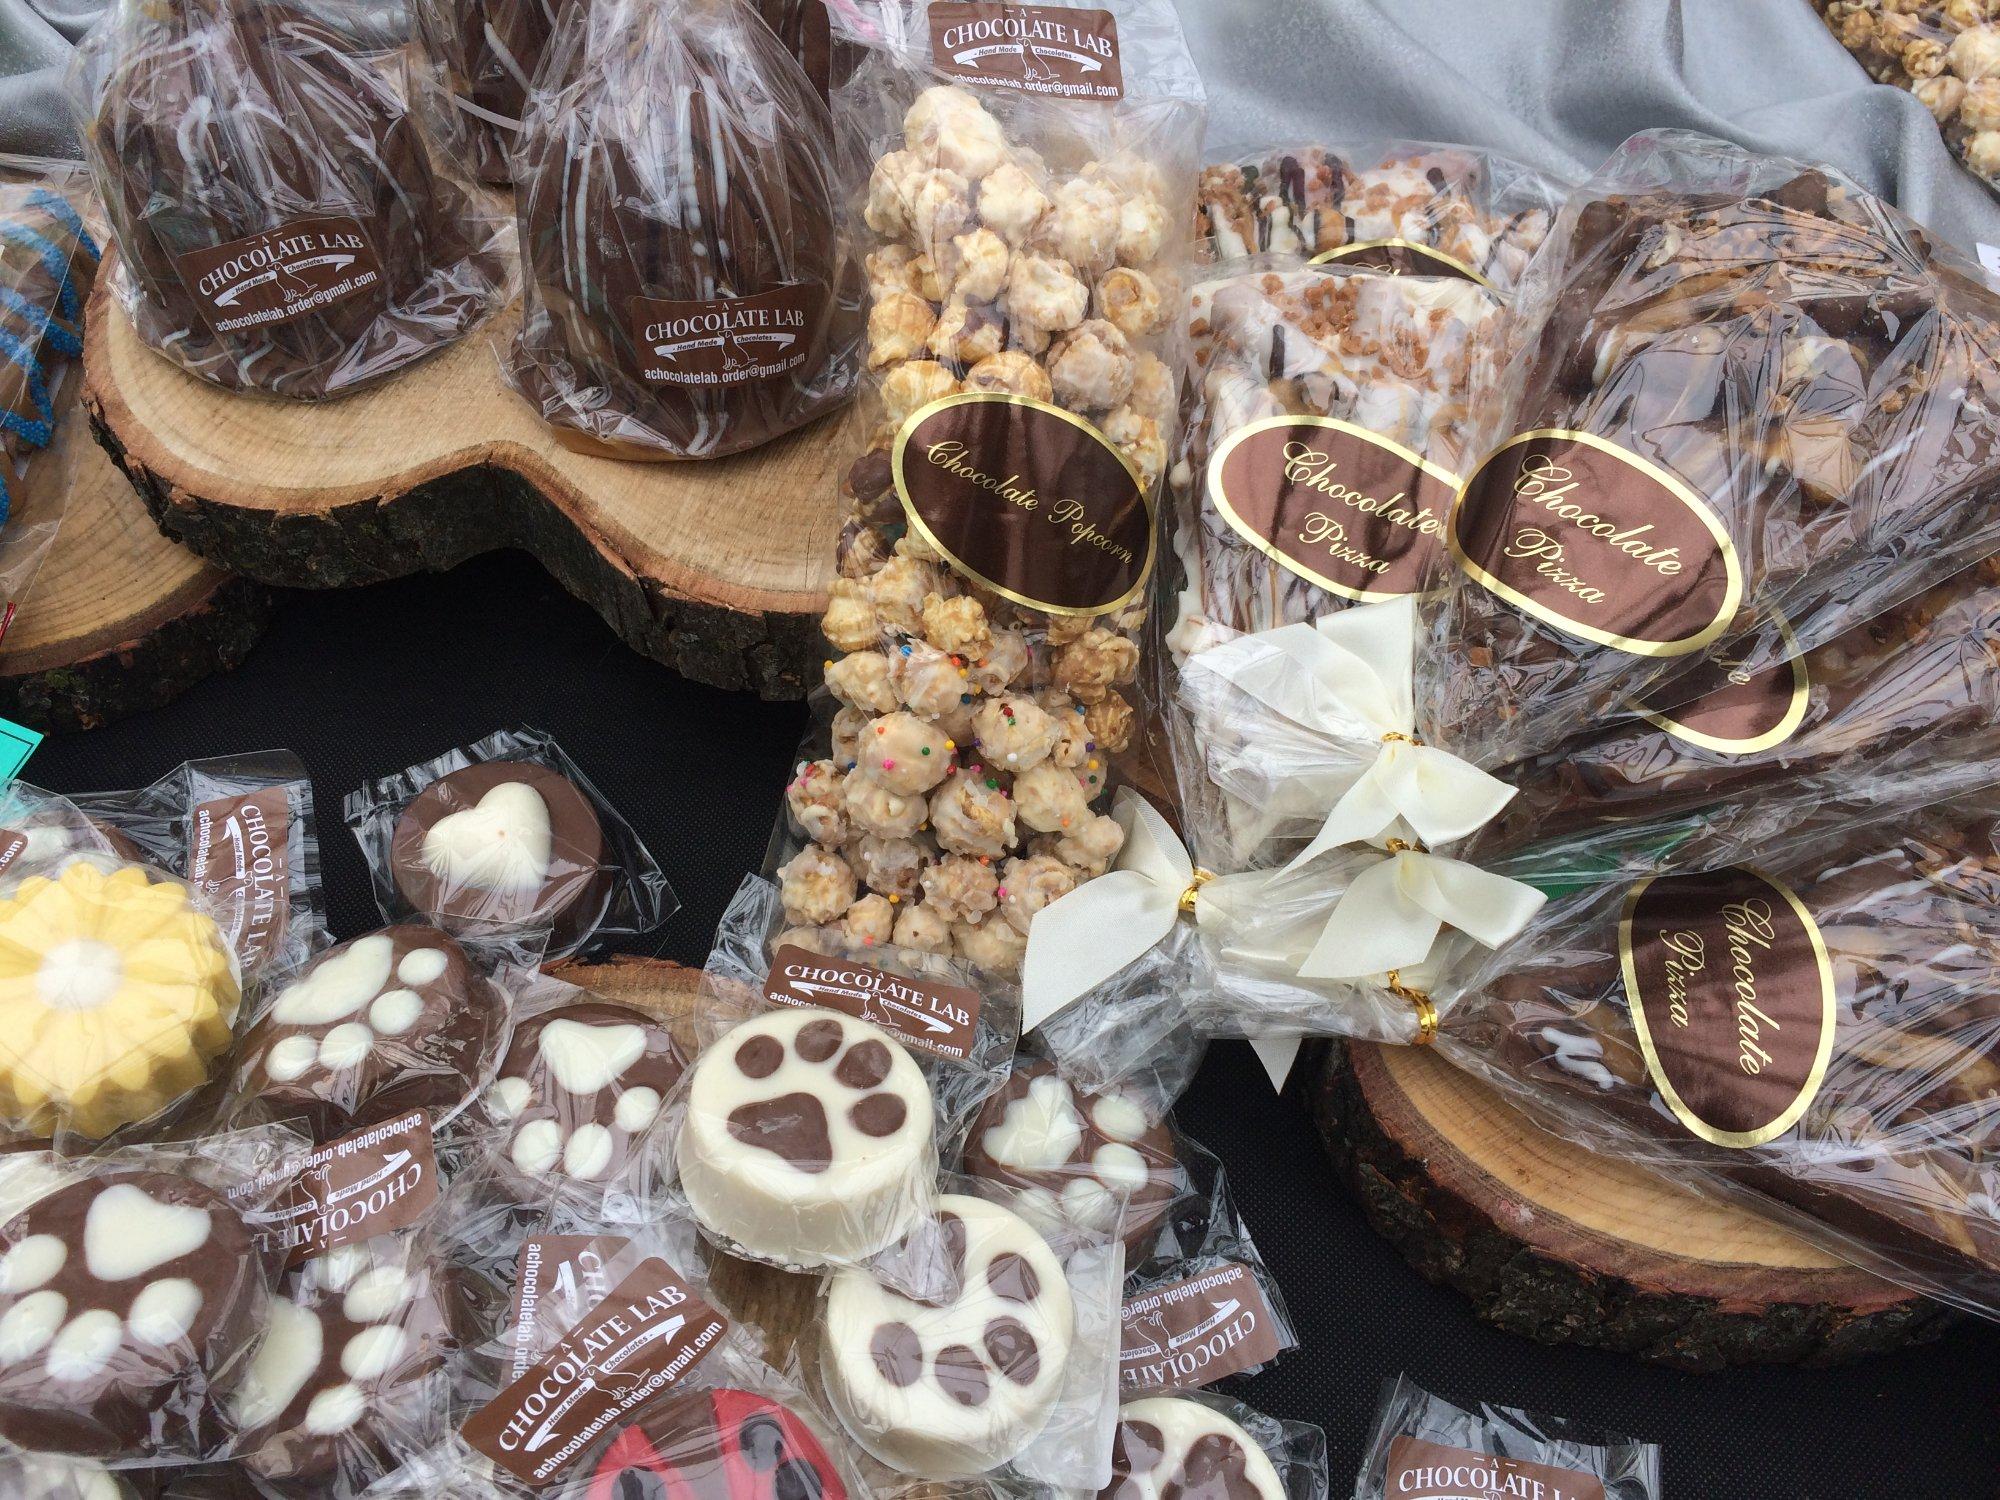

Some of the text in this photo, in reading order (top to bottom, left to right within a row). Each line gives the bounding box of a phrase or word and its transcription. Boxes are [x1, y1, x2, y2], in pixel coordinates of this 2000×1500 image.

[943, 18, 1113, 58] CHOCOLATE LAB
[1019, 9, 1027, 17] A
[978, 45, 1072, 59] Hand Made Chocolates
[199, 234, 364, 296] CHOCOLATE LAB
[261, 236, 270, 244] A
[216, 270, 377, 332] achocolatelab.order@gmail.com
[235, 257, 324, 293] Hand Made Chocolates
[645, 309, 804, 342] CHOCOLATE LAB
[721, 302, 729, 310] A
[645, 352, 806, 384] achocolatelab.order@gmail.com
[677, 333, 772, 351] Hand Made Chocolates
[927, 440, 1132, 564] Chocolate Popcorn
[1283, 441, 1439, 534] Chocolate
[1514, 454, 1682, 575] Chocolate
[1299, 512, 1390, 574] Pizza
[1504, 528, 1605, 604] Pizza
[234, 837, 243, 853] Hand
[241, 805, 275, 926] CHOCOLATE
[276, 874, 285, 882] A
[784, 964, 970, 1026] CHOCOLATE LAB
[818, 985, 922, 1018] Hand Made Chocolates
[1660, 929, 1706, 1028] Pizza
[1716, 898, 1781, 1075] Chocolate
[278, 1163, 422, 1250] CHOCOLATE
[335, 1186, 359, 1200] Made
[361, 1172, 383, 1189] Hand
[512, 1243, 543, 1383] achocolatelab.orde
[1120, 1317, 1216, 1359] Hand Made Chocolate
[498, 1285, 687, 1451] CHOCOLATE LAB
[560, 1342, 572, 1353] A
[1124, 1310, 1255, 1384] CHOCOLATE
[532, 1321, 722, 1479] achocolatelab.order@gmail.com
[548, 1335, 649, 1427] Hand Made Chocolates
[1490, 1458, 1500, 1469] A
